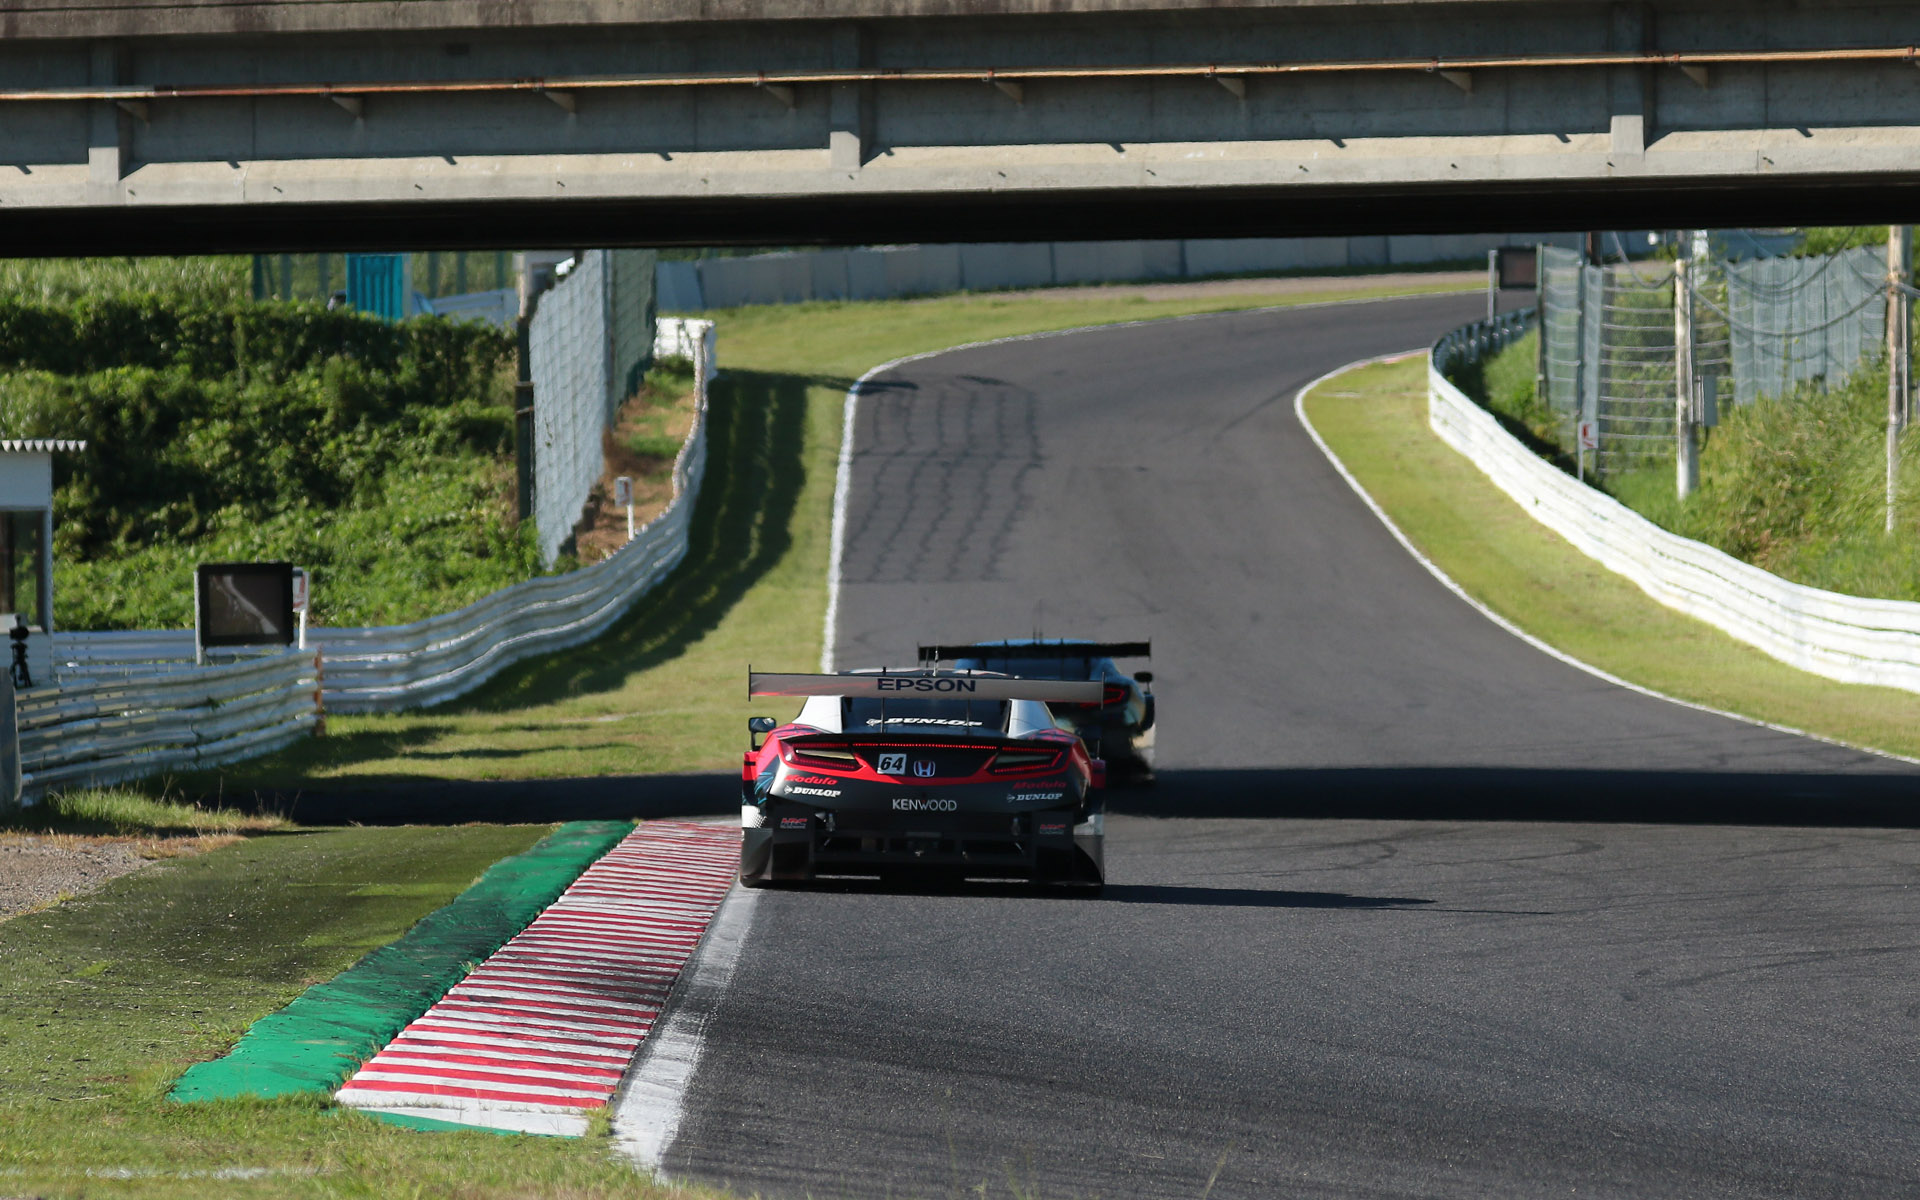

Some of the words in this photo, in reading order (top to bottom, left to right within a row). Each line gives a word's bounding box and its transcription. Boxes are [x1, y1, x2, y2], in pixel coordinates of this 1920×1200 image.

[877, 678, 976, 692] EPSON
[884, 717, 983, 727] DUNLOP
[880, 757, 904, 771] 64
[792, 786, 842, 798] DUNLOP
[1016, 792, 1063, 801] DUNLOP
[892, 798, 957, 812] KENWOOD
